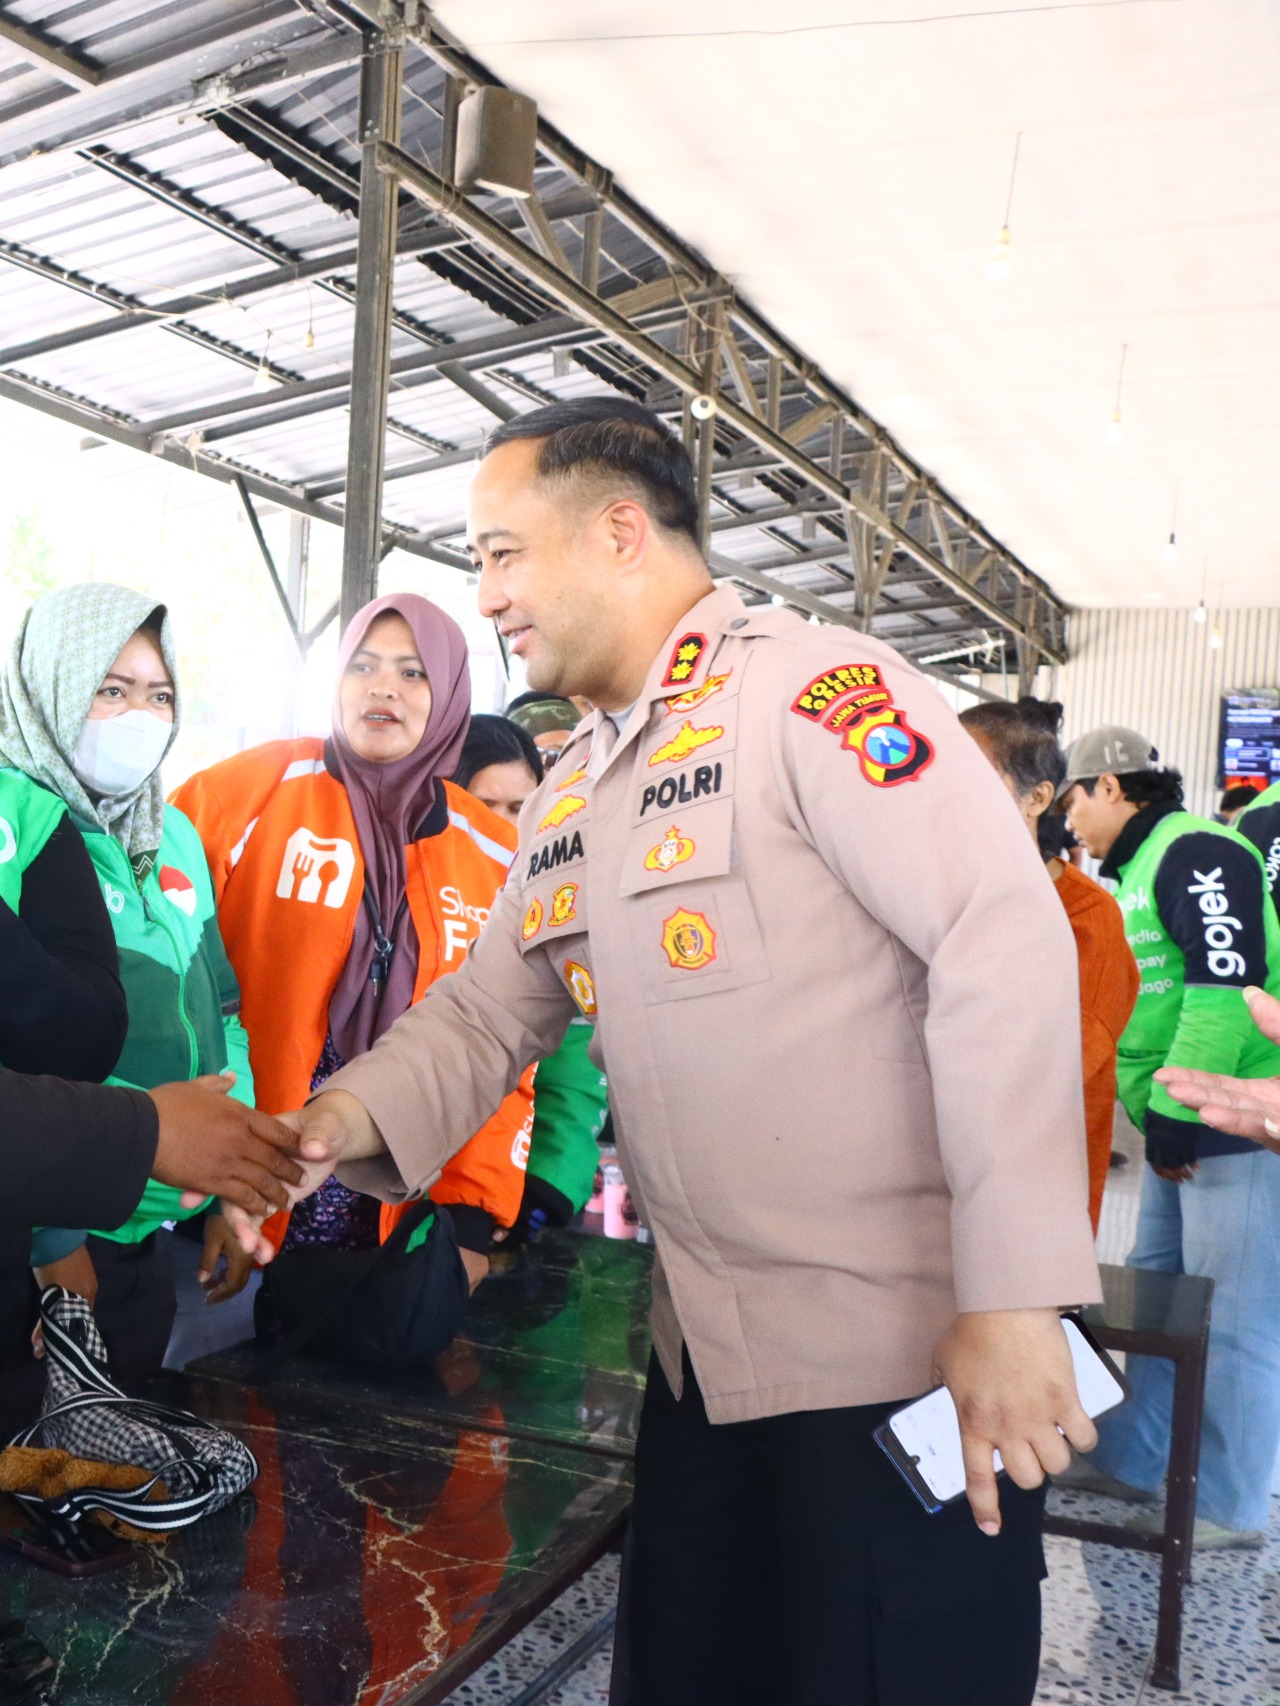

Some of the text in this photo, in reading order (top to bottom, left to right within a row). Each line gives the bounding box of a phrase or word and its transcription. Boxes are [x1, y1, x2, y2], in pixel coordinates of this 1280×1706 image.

[799, 666, 877, 709] POLRES
[813, 676, 876, 710] GRESIK
[831, 692, 889, 728] JAWA TIMUR
[639, 762, 722, 817] POLRI
[526, 830, 584, 881] RAMA
[439, 886, 490, 933] Shop
[1187, 866, 1246, 977] gojek
[1137, 954, 1166, 970] pay
